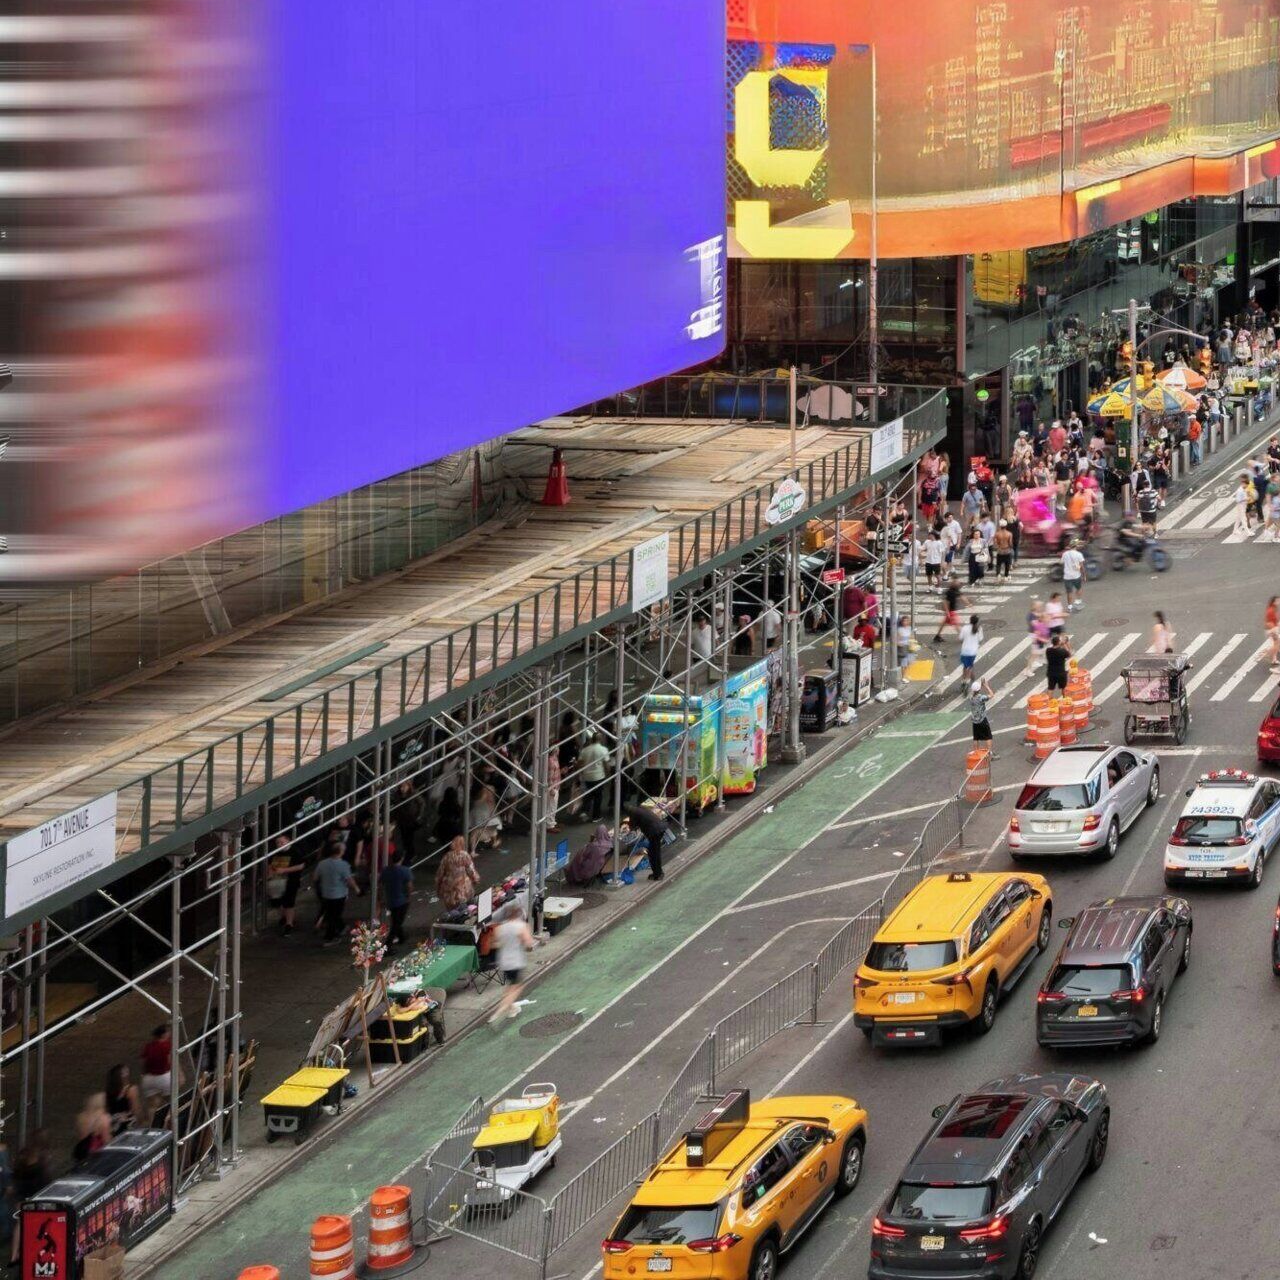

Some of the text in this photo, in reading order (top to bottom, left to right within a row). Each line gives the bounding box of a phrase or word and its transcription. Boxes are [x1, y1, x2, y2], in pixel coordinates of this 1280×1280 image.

[637, 540, 666, 562] SPRING
[1191, 806, 1235, 814] 743923
[40, 826, 52, 848] 701
[63, 809, 89, 838] AVENUE
[35, 1262, 56, 1275] MJ
